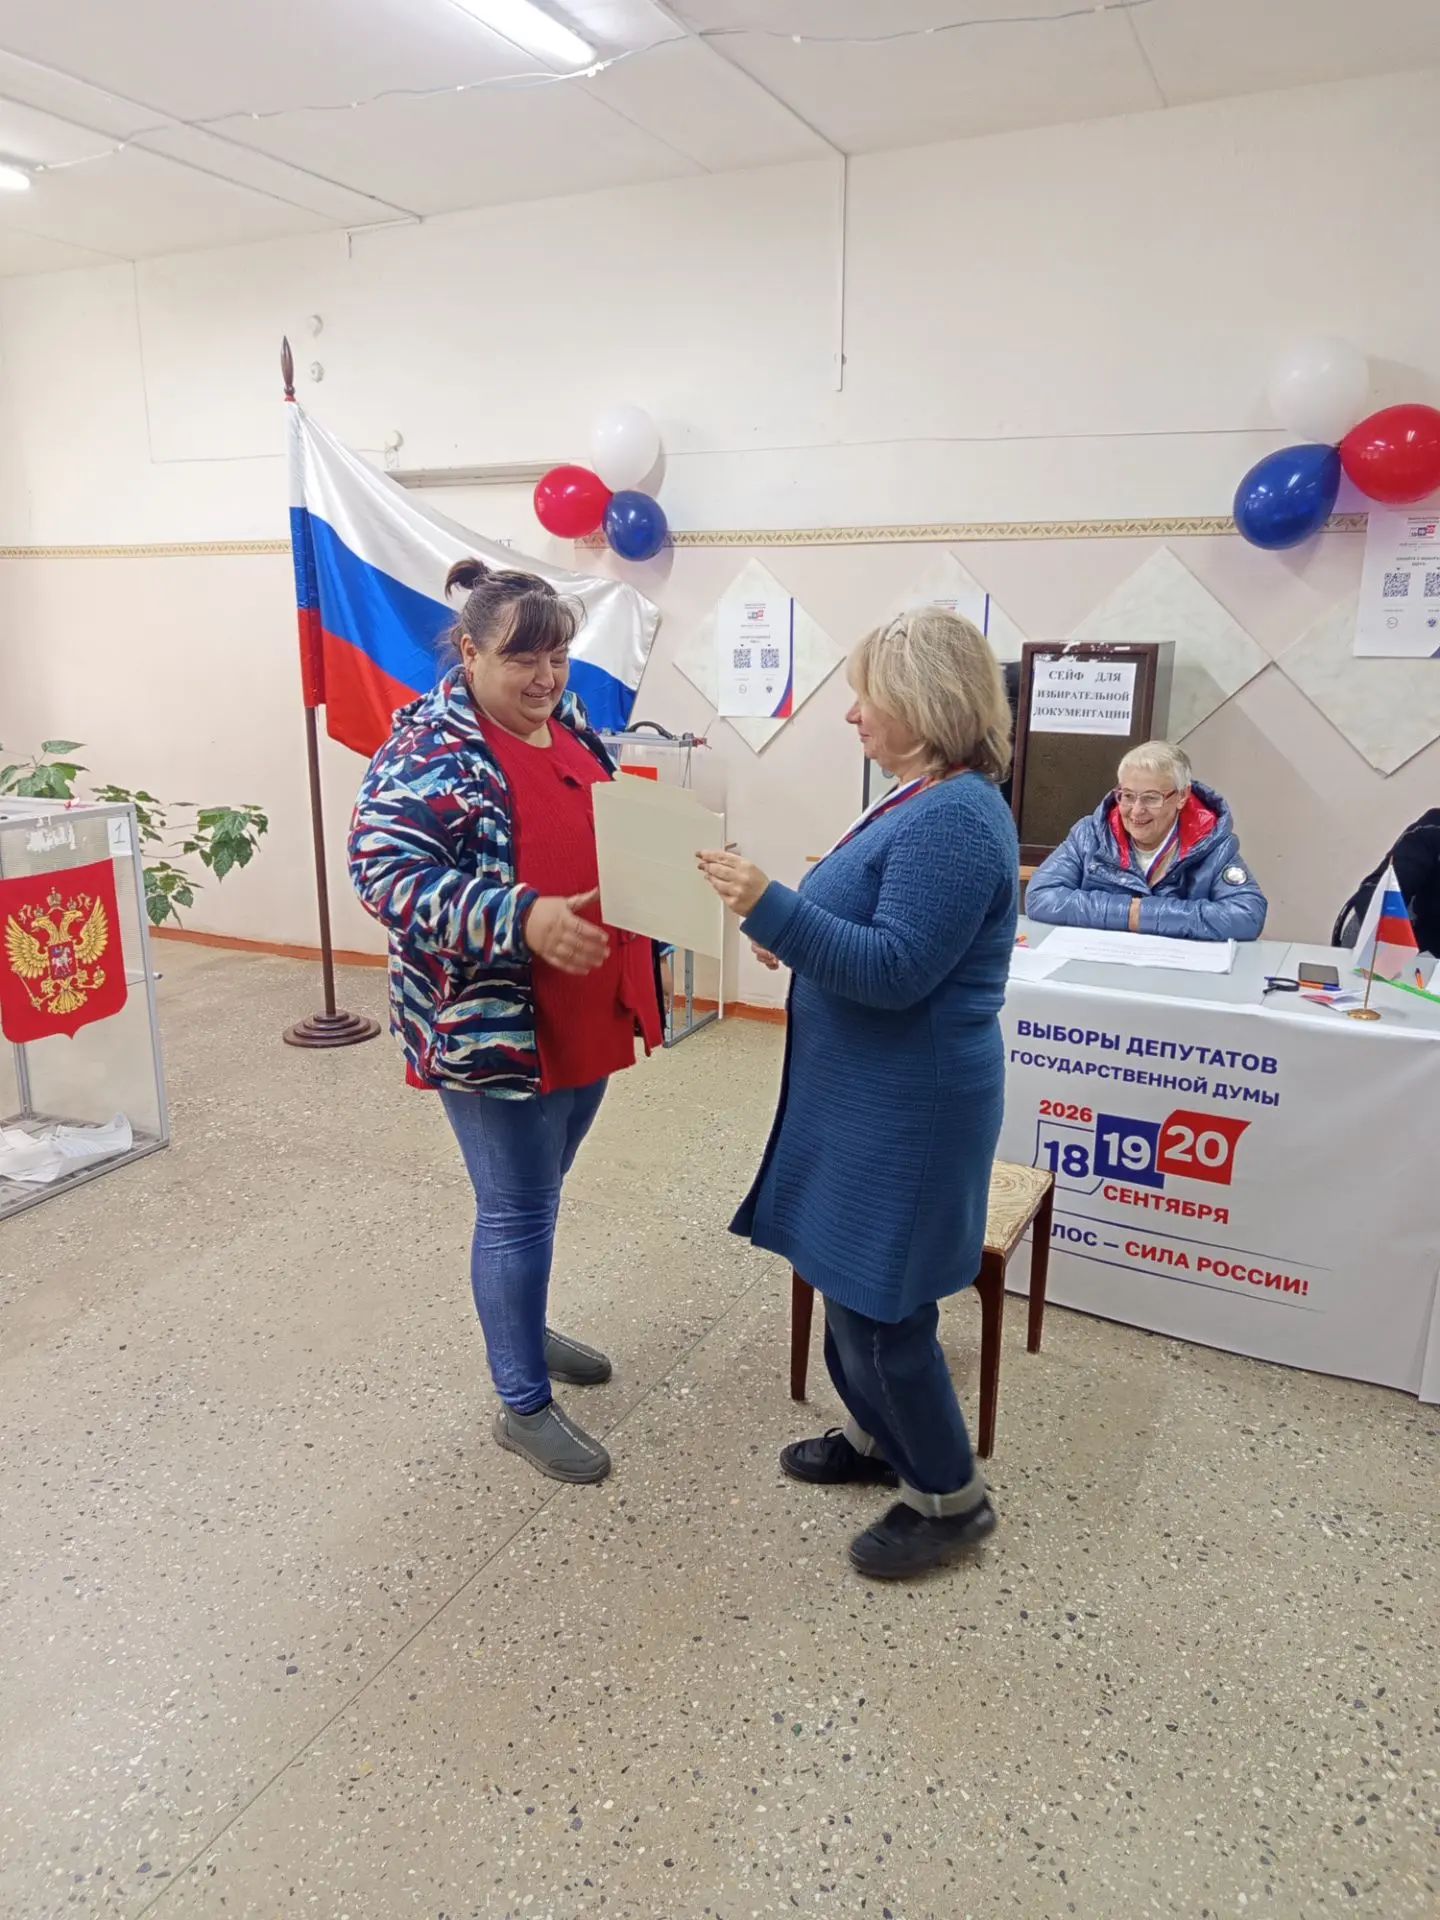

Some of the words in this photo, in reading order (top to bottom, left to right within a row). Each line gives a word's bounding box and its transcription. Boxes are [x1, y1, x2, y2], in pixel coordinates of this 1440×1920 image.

[1048, 669, 1084, 681] СЕЙФ
[1094, 671, 1121, 682] ДЛЯ
[1037, 689, 1130, 701] ИЗБИРАТЕЛЬНОЙ
[1032, 706, 1130, 720] ДОКУМЕНТАЦИИ
[113, 822, 126, 844] 1
[1017, 1020, 1120, 1051] ВЫБОРЫ
[1125, 1036, 1278, 1075] ДЕПУТАТОВ
[1010, 1050, 1208, 1095] ГОСУДАРСТВЕННОЙ
[1212, 1083, 1279, 1107] ДУМЫ
[1038, 1099, 1093, 1123] 2026
[1043, 1140, 1090, 1179] 18
[1102, 1131, 1151, 1171] 19
[1164, 1124, 1229, 1168] 20
[1103, 1184, 1230, 1225] СЕНТЯБРЯ
[1051, 1223, 1098, 1247] ЛОС
[1124, 1240, 1190, 1269] СИЛА
[1196, 1256, 1309, 1296] РОССИИ!
